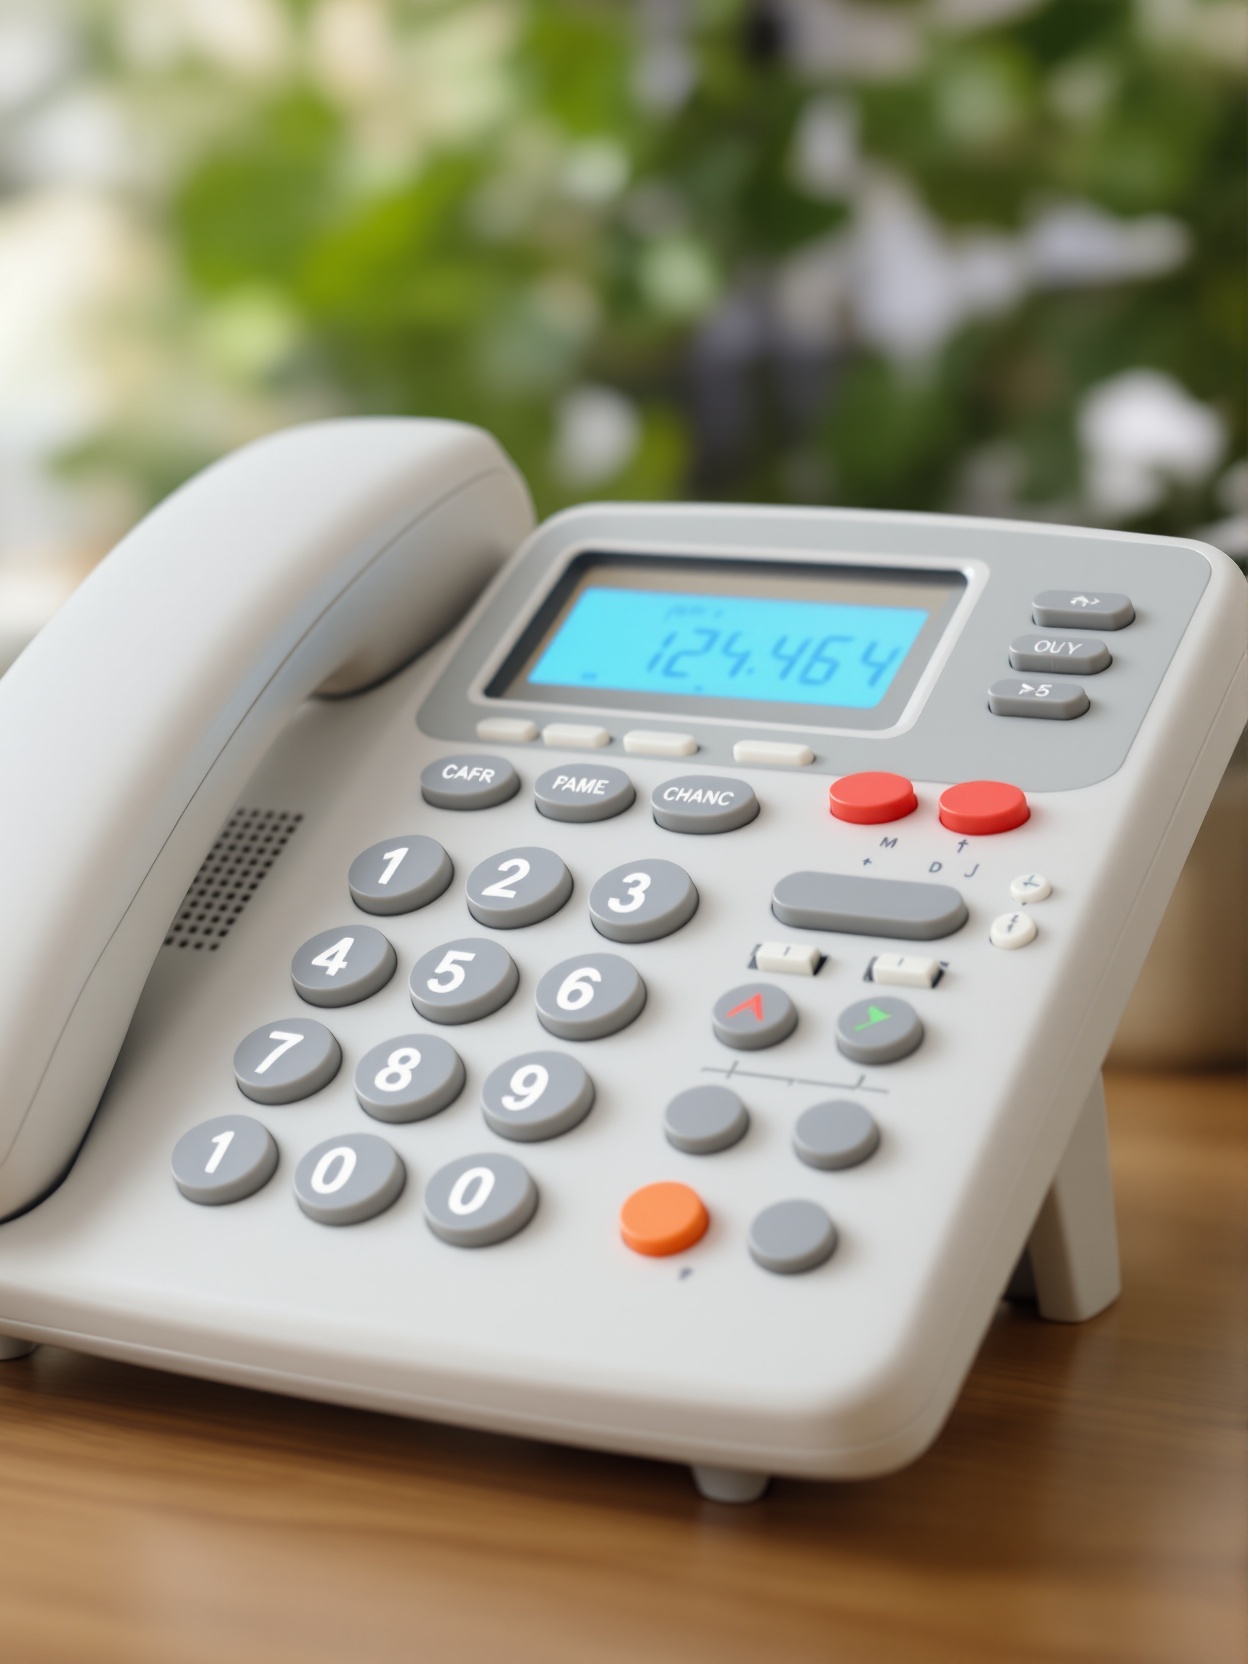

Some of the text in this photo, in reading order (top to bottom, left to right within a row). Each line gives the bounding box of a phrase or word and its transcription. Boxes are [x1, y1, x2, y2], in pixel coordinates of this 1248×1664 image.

[441, 763, 496, 784] CAFR
[662, 786, 735, 807] CHANC
[879, 836, 899, 850] M
[377, 846, 410, 886] 1
[481, 857, 531, 899] 2
[927, 861, 944, 874] D
[606, 871, 652, 914] 3
[310, 936, 356, 977] 4
[425, 949, 477, 994] 5
[554, 966, 603, 1011] 6
[254, 1029, 305, 1075] 7
[373, 1046, 422, 1093] 8
[500, 1063, 550, 1112] 9
[203, 1130, 236, 1174] 1
[309, 1145, 358, 1195] 0
[446, 1165, 497, 1217] 0
